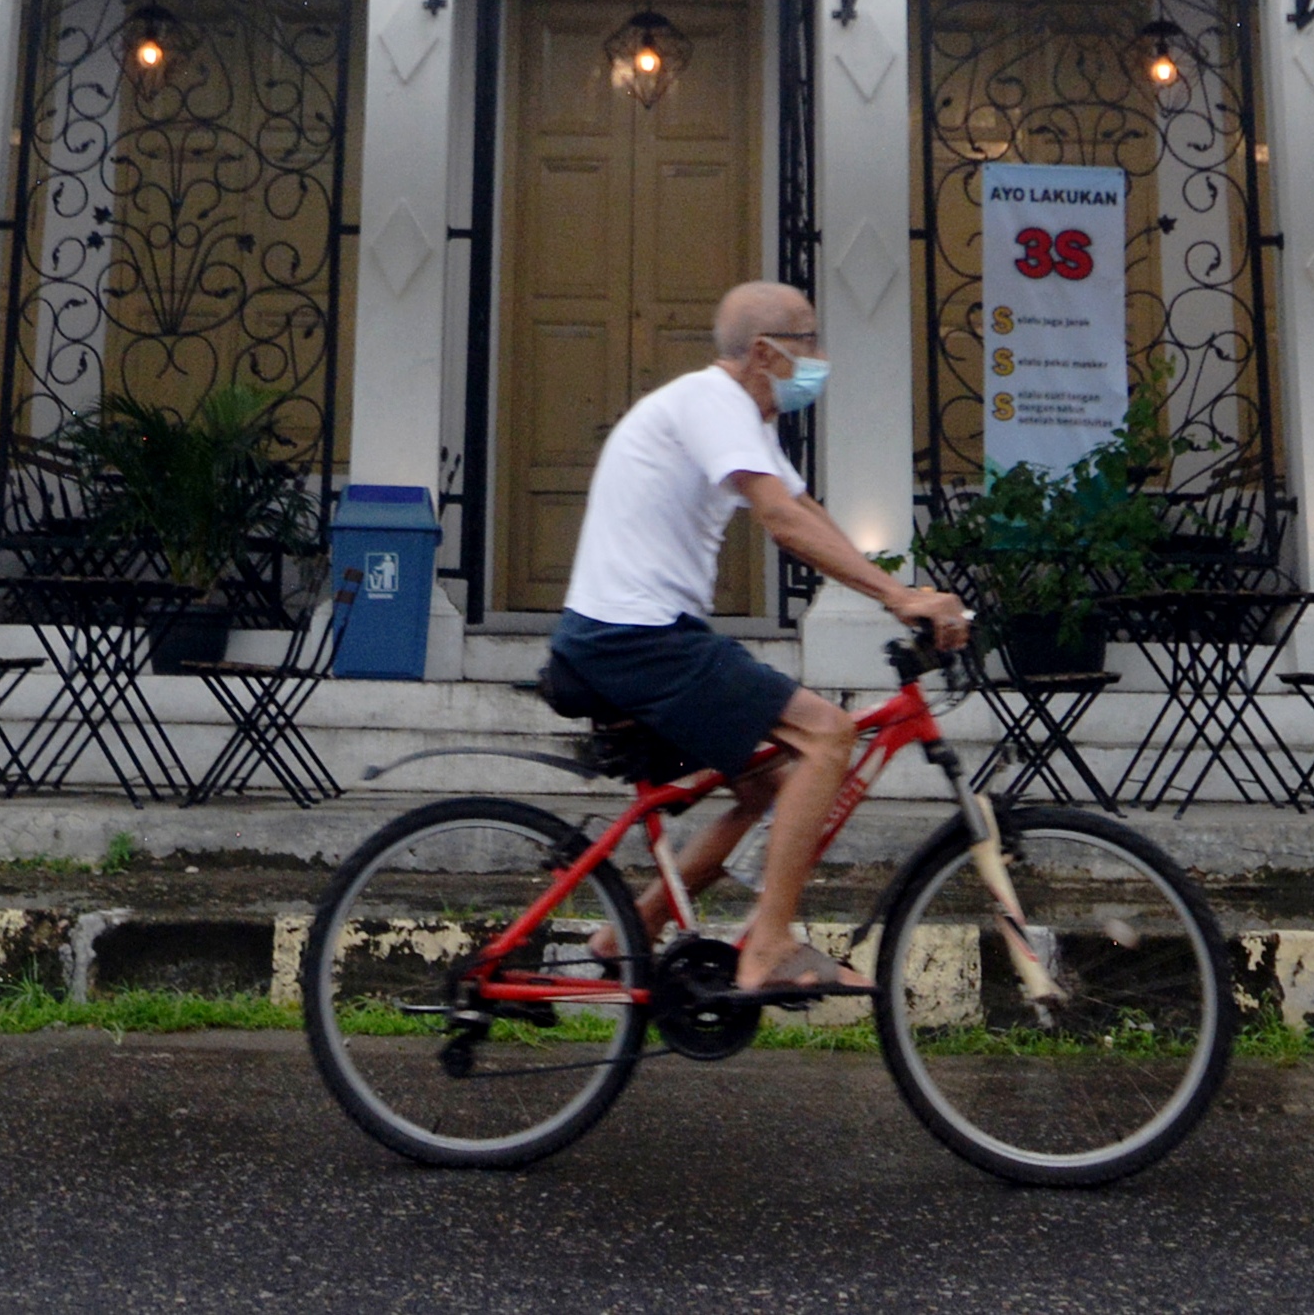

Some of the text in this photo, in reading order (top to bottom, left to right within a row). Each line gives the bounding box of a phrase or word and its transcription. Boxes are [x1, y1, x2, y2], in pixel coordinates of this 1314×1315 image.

[990, 186, 1118, 207] AYO LAKUKAN
[1014, 226, 1094, 281] 3S
